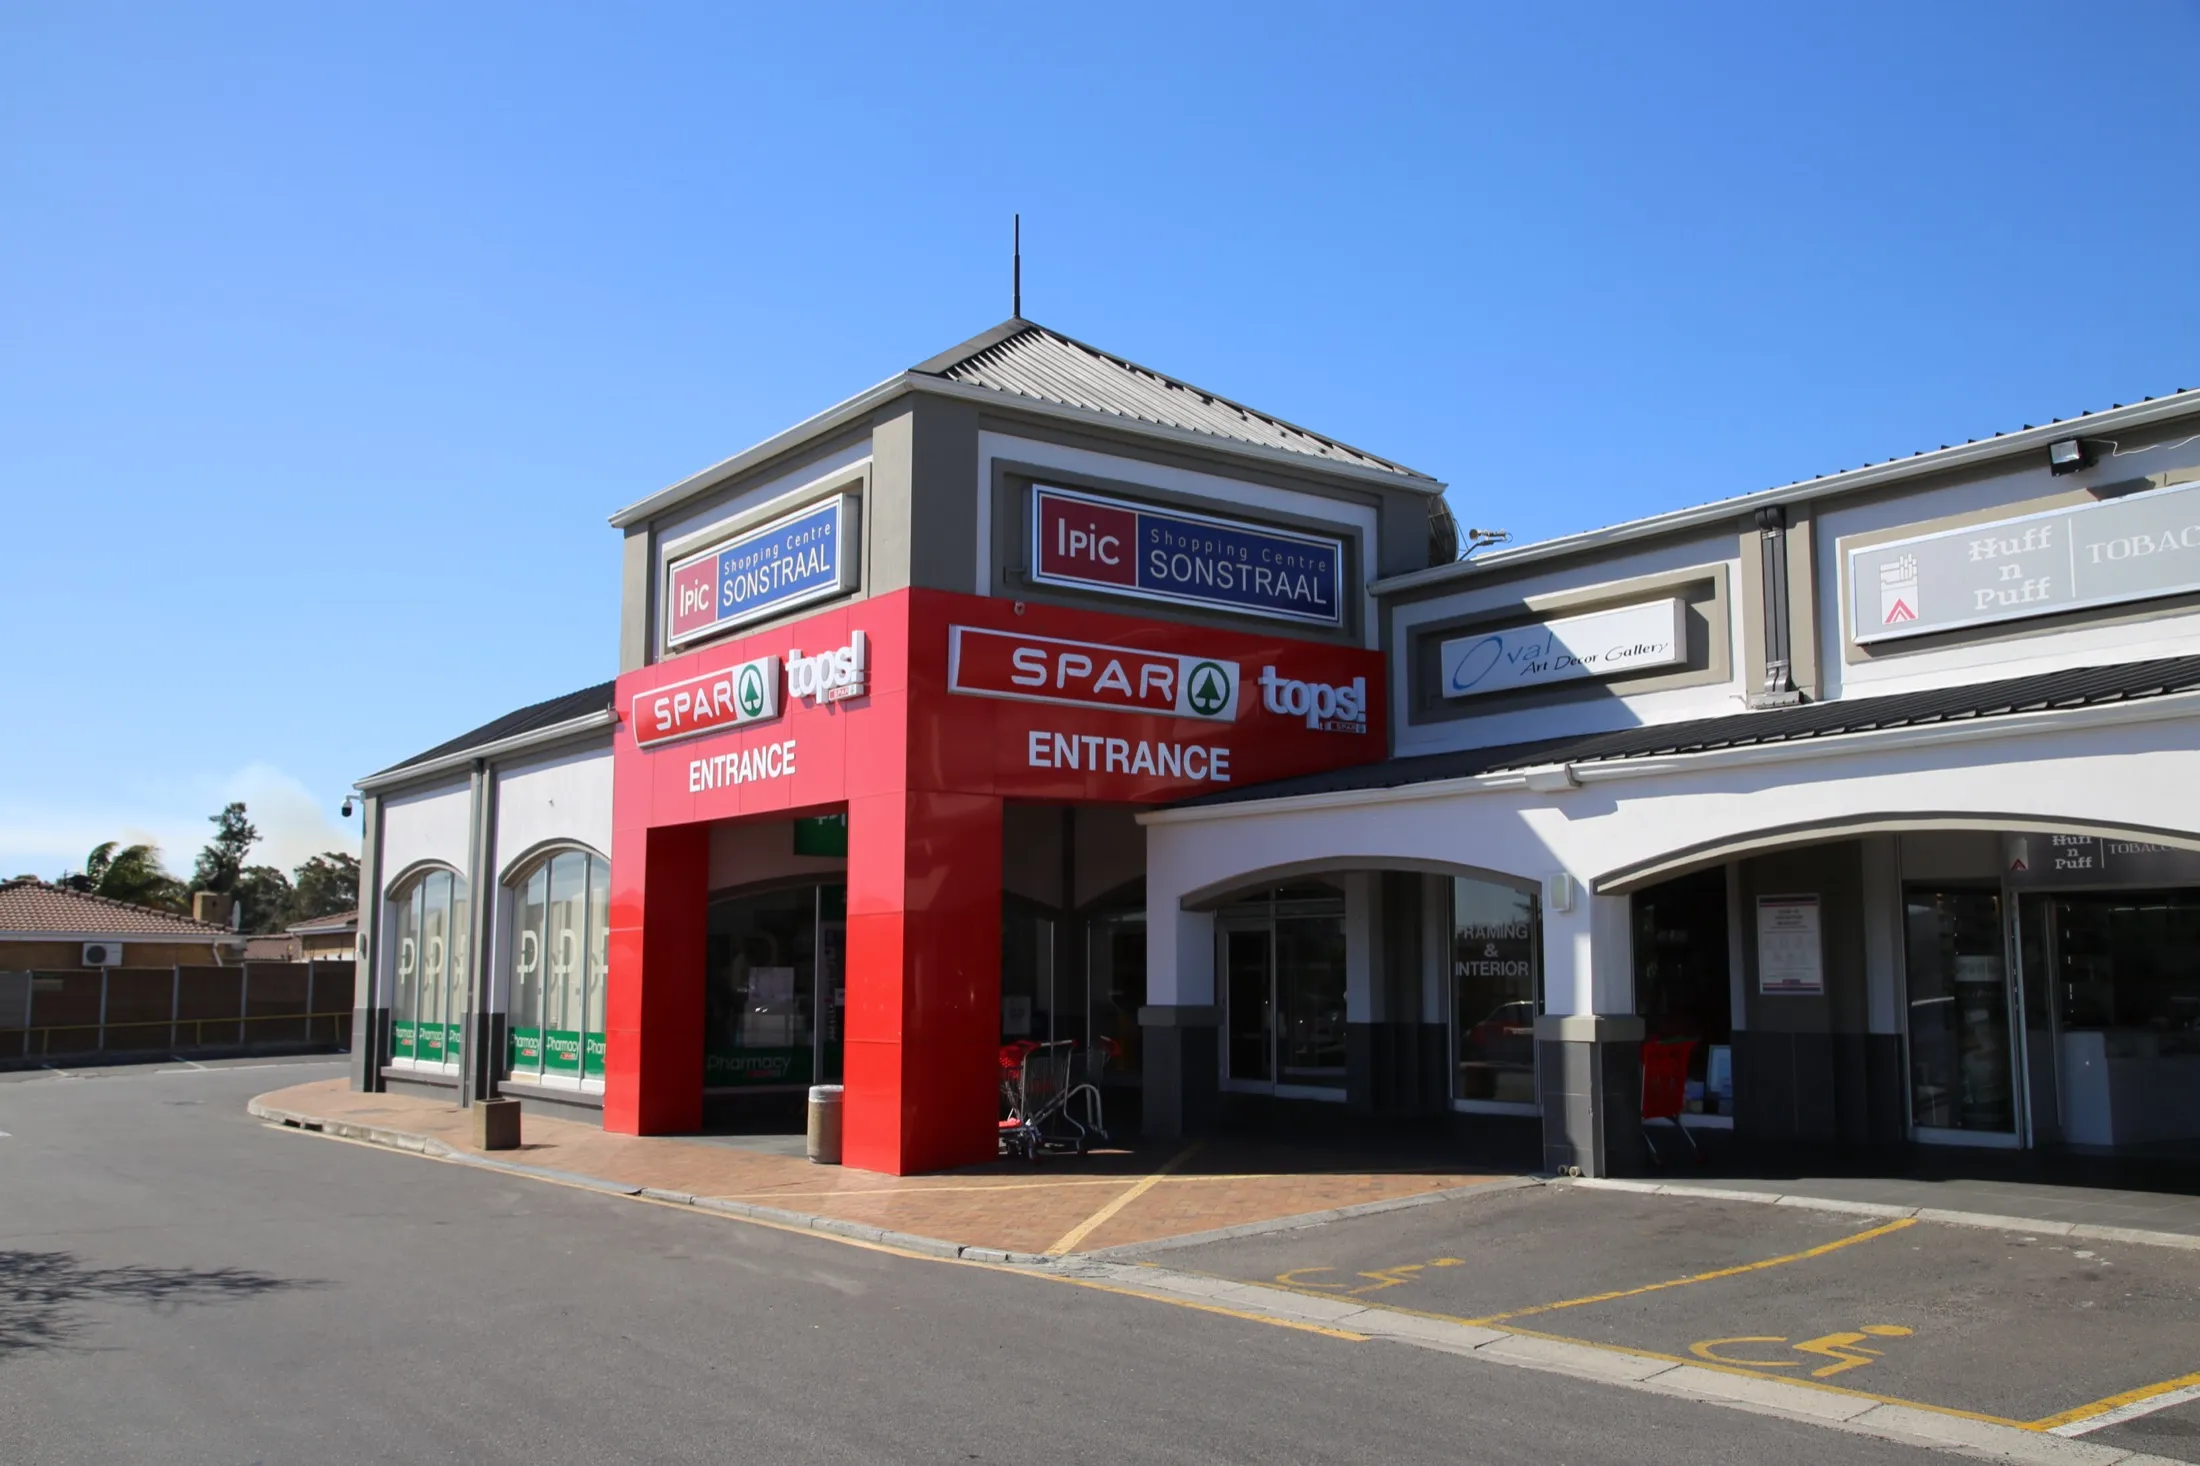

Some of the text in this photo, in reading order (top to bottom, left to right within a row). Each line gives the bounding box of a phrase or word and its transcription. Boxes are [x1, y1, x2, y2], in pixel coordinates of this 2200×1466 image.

[724, 522, 832, 575] Shopping Centre
[1150, 527, 1328, 573] Shopping Centre
[1968, 524, 2052, 562] Huff
[722, 545, 831, 607] SONSTRAAL
[1149, 550, 1328, 605] SONSTRAAL
[1974, 577, 2052, 611] Puff
[1998, 563, 2023, 582] n
[785, 629, 864, 704] tops!
[1011, 646, 1175, 702] SPAR
[1453, 632, 1553, 690] Oval
[1520, 641, 1669, 676] Art Decor Gallery
[653, 680, 733, 731] SPAR
[1257, 665, 1366, 729] tops!
[689, 740, 797, 793] ENTRANCE
[1028, 730, 1231, 782] ENTRANCE
[2054, 857, 2093, 869] Puff
[2067, 848, 2079, 857] n
[1454, 923, 1529, 939] FRAMING
[1483, 942, 1499, 957] &
[1455, 960, 1529, 977] INTERIOR
[707, 1054, 792, 1074] Pharmacy
